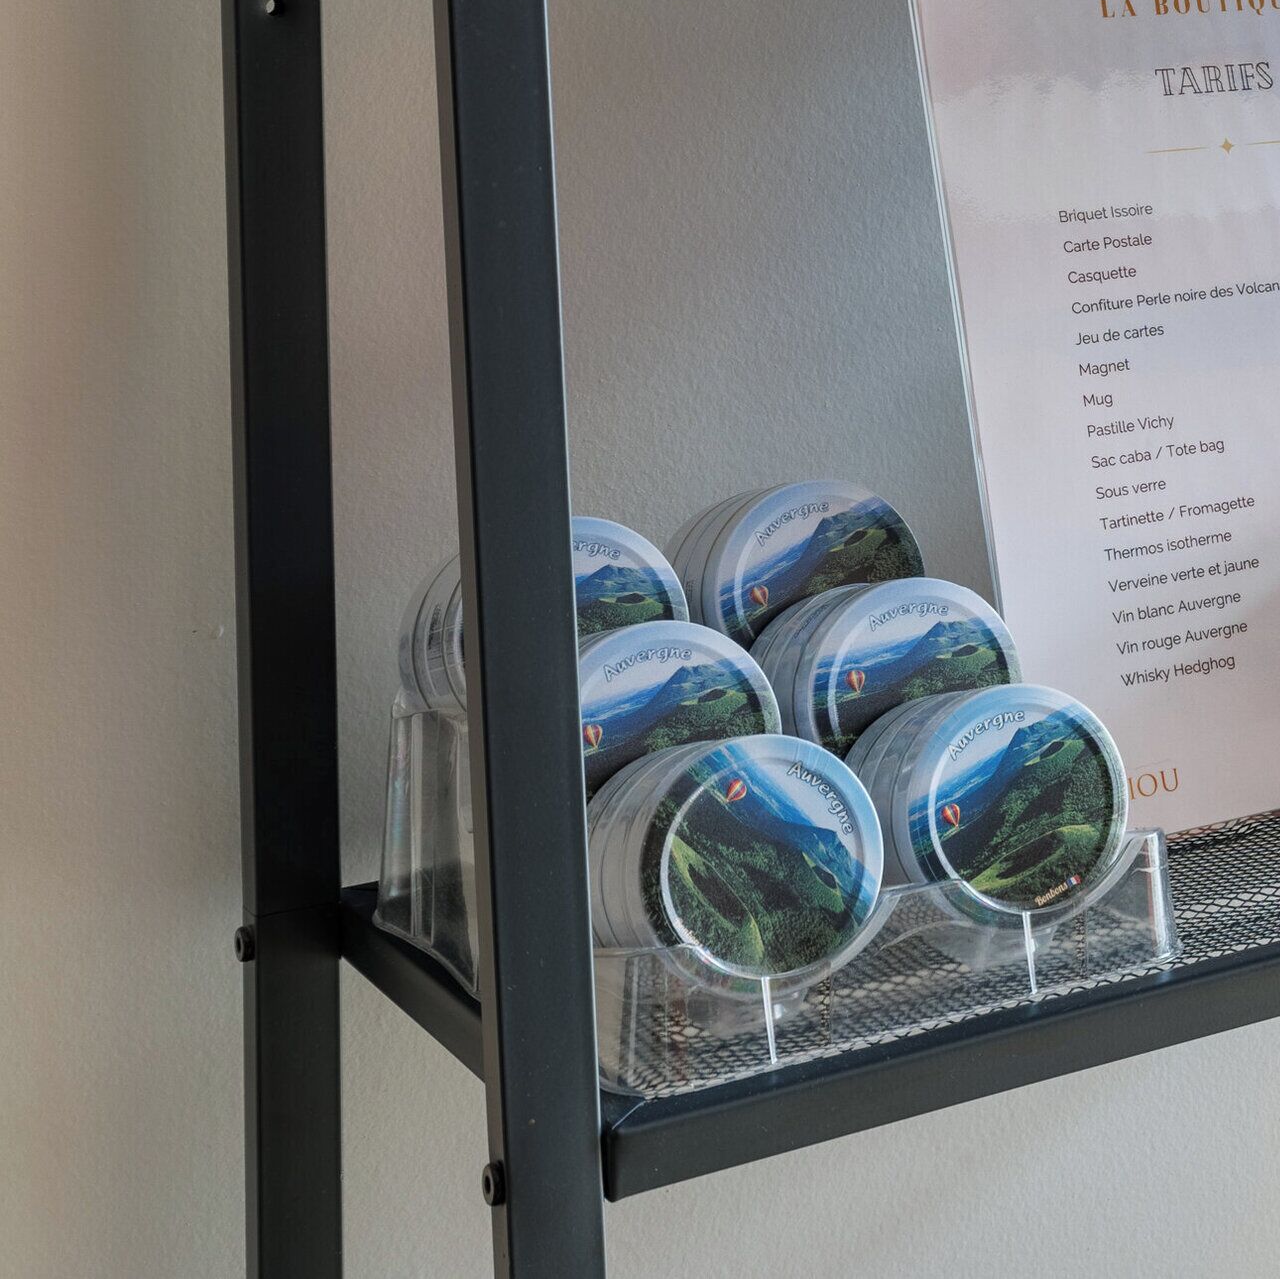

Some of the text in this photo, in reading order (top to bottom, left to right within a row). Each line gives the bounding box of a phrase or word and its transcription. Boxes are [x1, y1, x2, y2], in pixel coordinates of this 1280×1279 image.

[1154, 61, 1274, 96] TARIFS
[1058, 203, 1153, 224] Briquet Issoire
[1063, 233, 1153, 253] Carte Postale
[1067, 266, 1137, 284] Casquette
[1071, 297, 1134, 314] Confiture
[1136, 292, 1171, 307] Perle
[1174, 288, 1207, 304] noire
[1210, 285, 1234, 299] des
[1076, 324, 1165, 346] Jeu de cartes
[1079, 358, 1130, 378] Magnet
[1083, 393, 1114, 408] Mug
[1087, 415, 1175, 438] Pastille Vichy
[1091, 455, 1116, 469] Sac
[1119, 449, 1151, 465] caba
[1166, 443, 1197, 458] Tote
[1200, 440, 1225, 454] bag
[1096, 479, 1166, 500] Sous verre
[753, 501, 829, 547] Auvergne
[1100, 511, 1164, 531] Tartinette
[1179, 496, 1255, 518] Fromagette
[572, 540, 621, 560] ergne
[1104, 531, 1232, 561] Thermos isotherme
[1108, 557, 1260, 593] Verveine verte et jaune
[868, 602, 949, 632] Auvergne
[1112, 591, 1242, 624] Vin blanc Auvergne
[1116, 621, 1248, 655] Vin rouge Auvergne
[602, 646, 692, 682] Auvergne
[1121, 655, 1236, 687] Whisky Hedghog
[947, 710, 1025, 761] Auvergne
[787, 761, 854, 835] Auvergne
[1128, 768, 1179, 800] IOU
[1034, 882, 1069, 907] Bonbons
